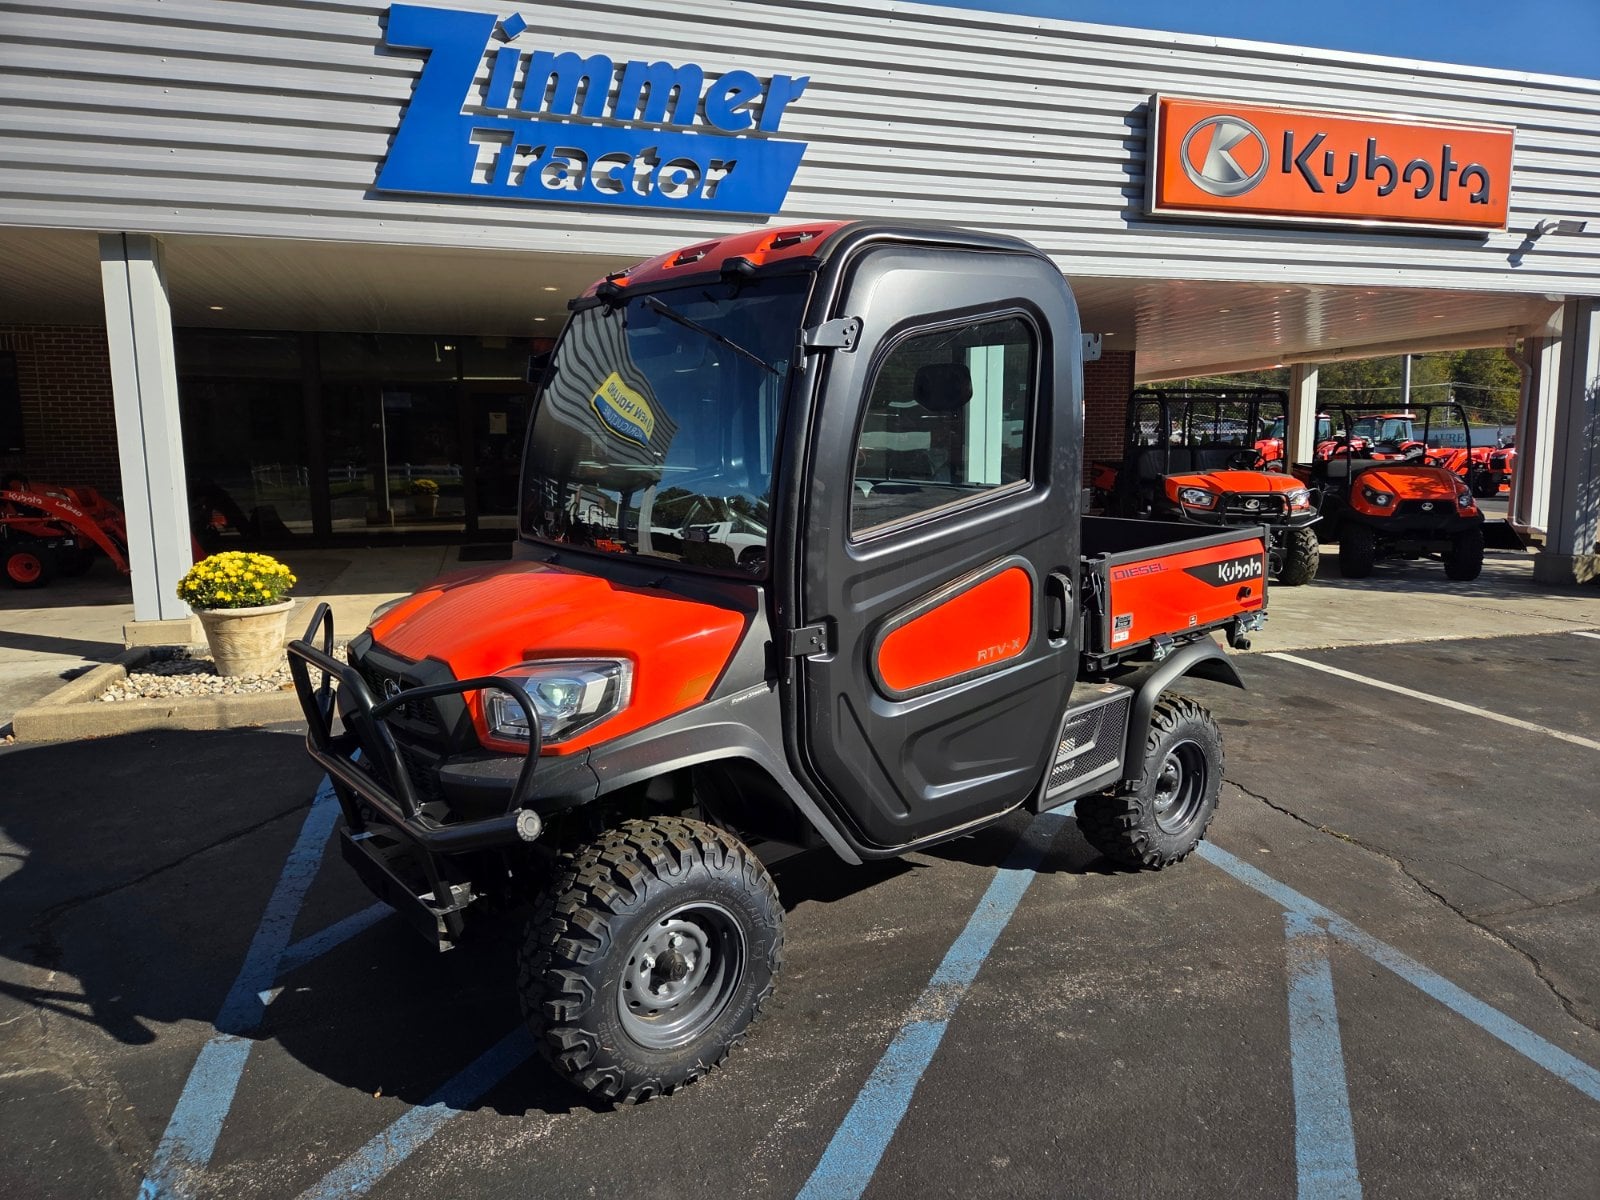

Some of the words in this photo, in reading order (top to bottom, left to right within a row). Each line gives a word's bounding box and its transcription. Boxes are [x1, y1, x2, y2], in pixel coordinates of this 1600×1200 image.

[377, 3, 811, 191] Zimmer
[469, 127, 738, 201] Tractor
[1281, 130, 1491, 205] Kubota
[8, 492, 43, 505] Kubota
[1113, 563, 1168, 580] DIESEL
[1218, 557, 1262, 582] Kubota
[977, 638, 1020, 662] RTV-X
